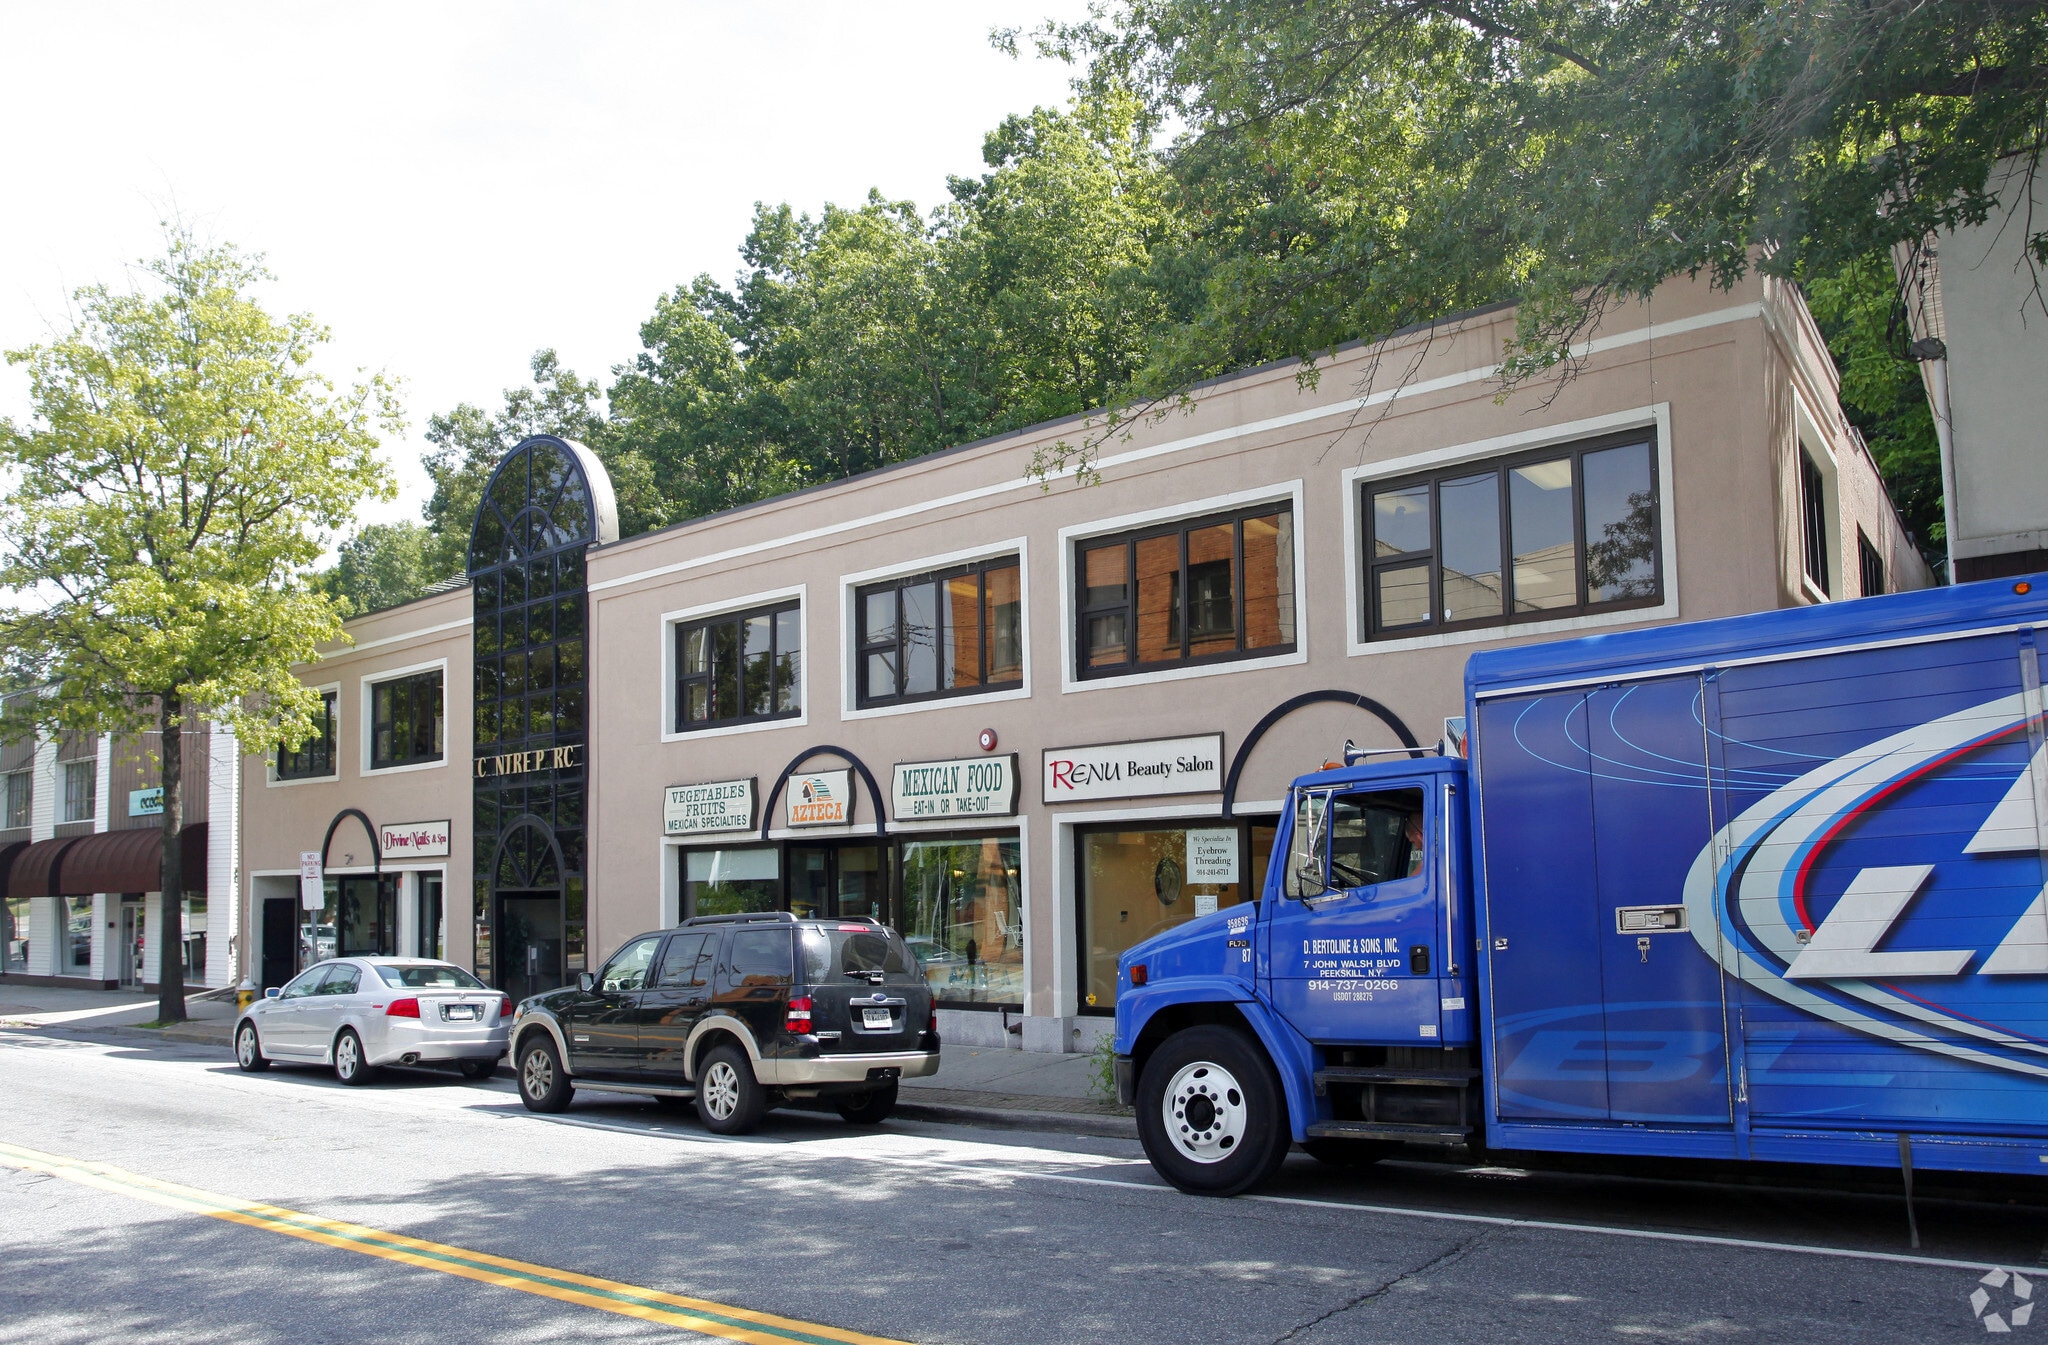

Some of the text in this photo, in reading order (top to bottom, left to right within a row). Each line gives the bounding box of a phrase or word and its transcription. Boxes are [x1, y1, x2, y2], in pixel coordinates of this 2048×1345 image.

[902, 763, 1003, 796] MEXICAN FOOD
[1049, 756, 1213, 790] RENU Beauty Salon
[672, 785, 745, 803] VEGETABLES
[686, 802, 726, 817] FRUITS
[792, 802, 843, 822] AZTECA
[914, 796, 989, 814] EAT-IN OR TAKE-OUT
[668, 815, 747, 830] MEXICAN SPECIALTIES
[383, 831, 447, 850] Divine Nails & Spa
[1197, 846, 1228, 857] Eyebrow
[1194, 856, 1232, 867] Threading
[1227, 915, 1249, 929] 958696
[1303, 937, 1400, 955] D. BERTOLINE & SONS, INC.
[1242, 948, 1251, 962] 87
[1312, 960, 1337, 968] JOHN
[1341, 960, 1373, 968] WALSH
[1376, 959, 1400, 968] BLVD
[1320, 969, 1365, 978] PEEKSKILL,
[1308, 980, 1398, 990] 914-737-0266
[1333, 992, 1351, 1001] USDOT
